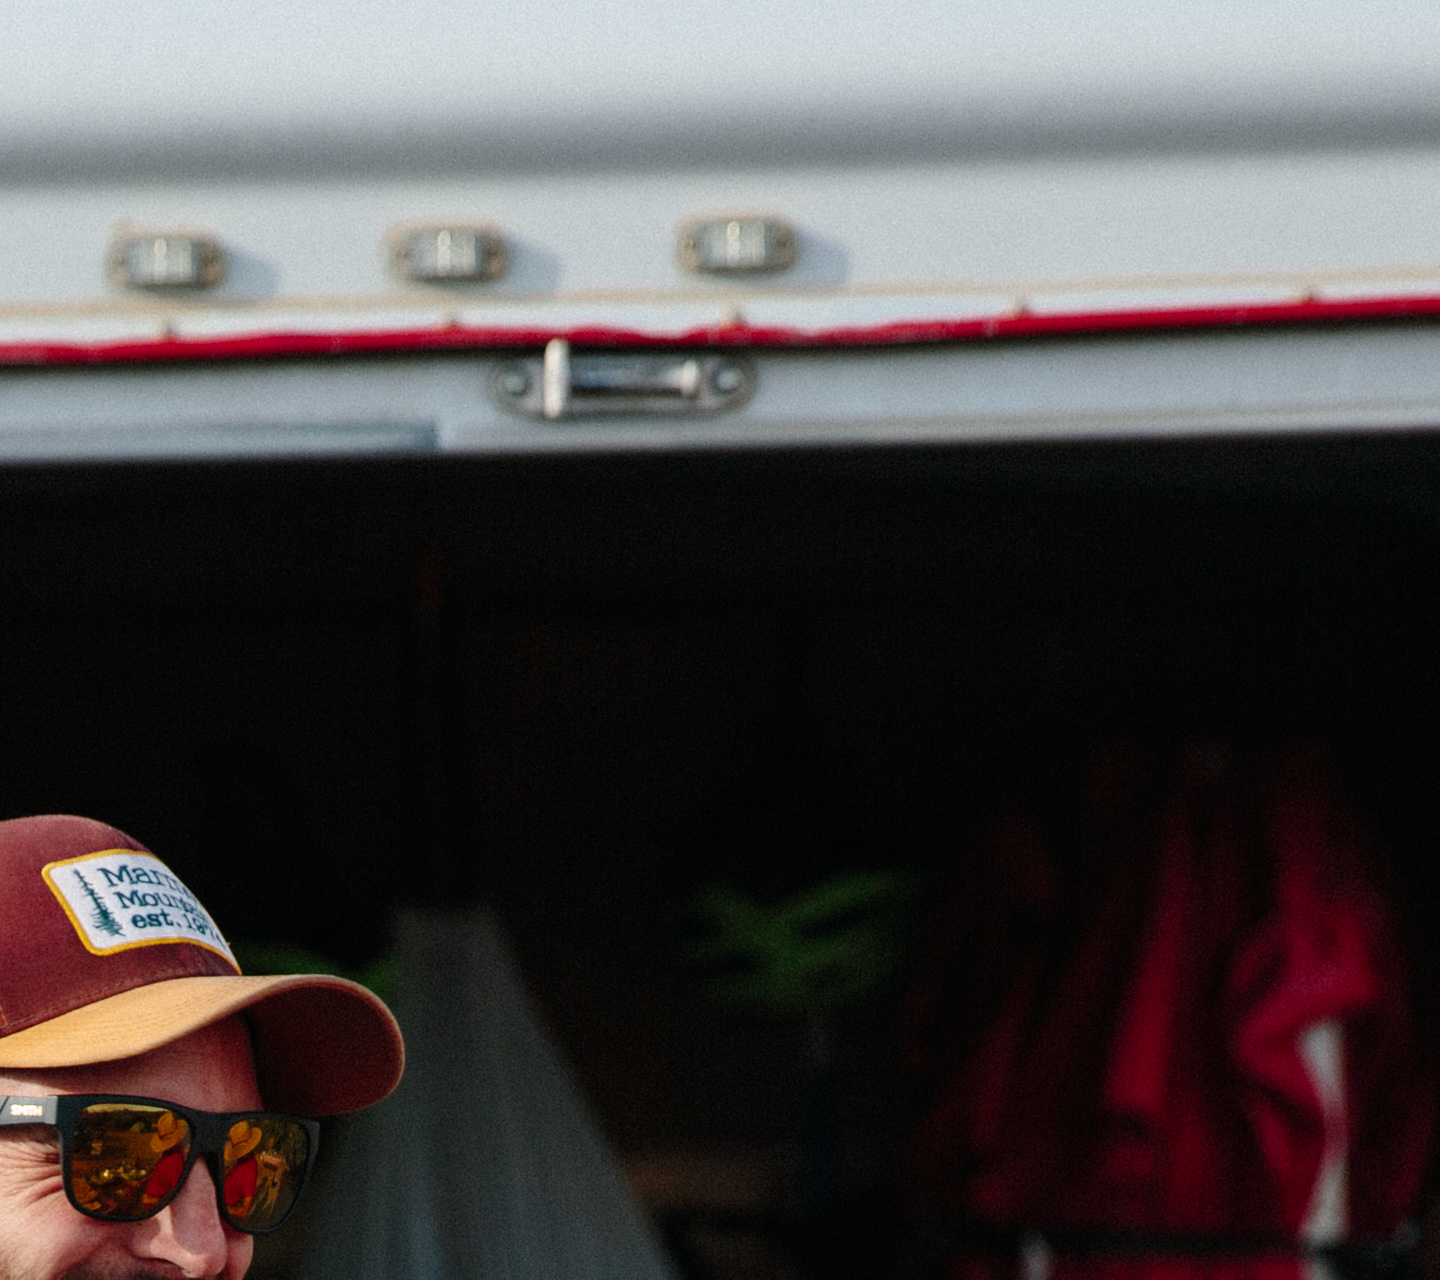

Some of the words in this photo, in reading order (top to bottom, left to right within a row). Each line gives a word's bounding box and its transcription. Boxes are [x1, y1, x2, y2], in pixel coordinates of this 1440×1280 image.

[96, 864, 194, 902] Marm
[131, 907, 182, 929] est.
[10, 1104, 43, 1116] SMITH
